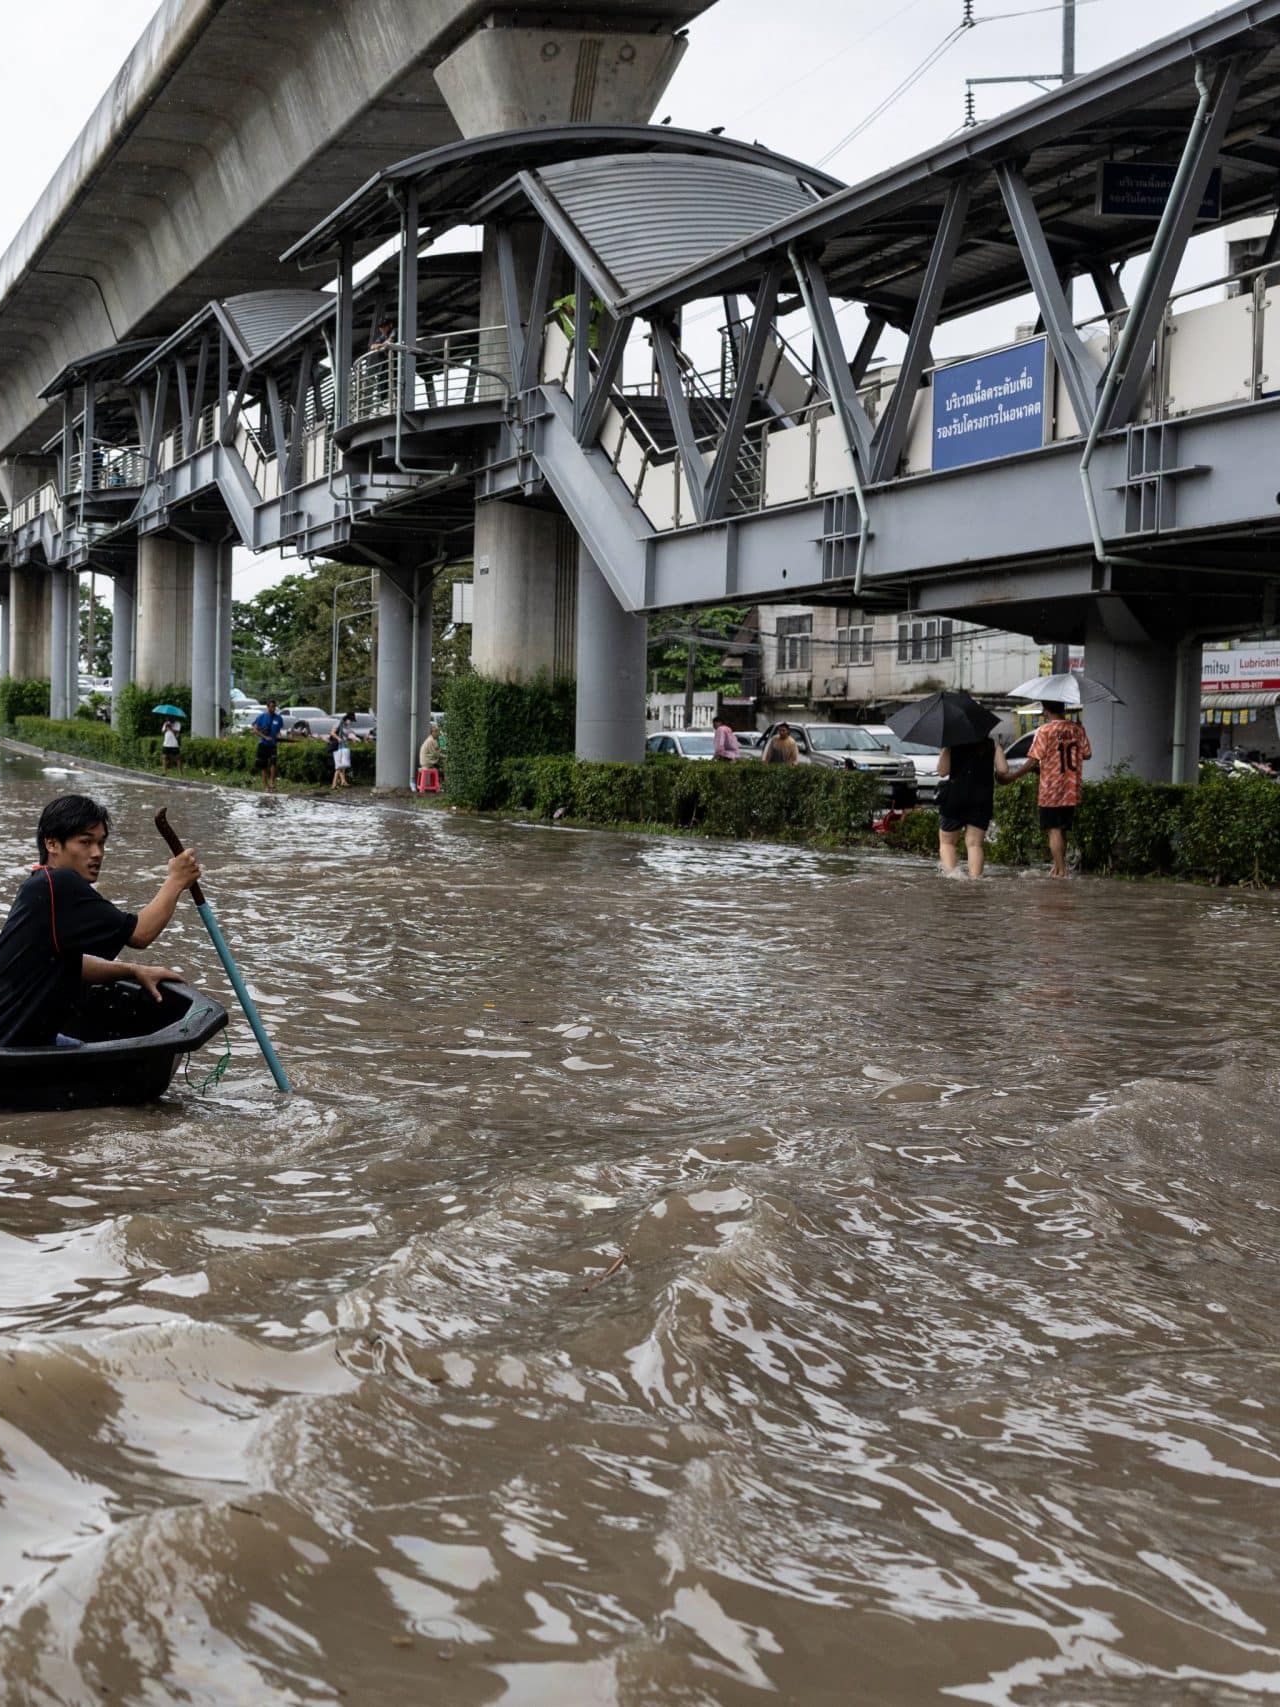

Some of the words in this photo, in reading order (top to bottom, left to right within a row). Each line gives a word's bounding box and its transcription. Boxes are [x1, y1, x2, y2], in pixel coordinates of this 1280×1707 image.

[946, 366, 1033, 411] บริเวณนี้ลดระดับเพื่อ
[936, 401, 1041, 439] รองรับโครงการในอนาคต
[1204, 659, 1230, 674] mitsu
[1240, 657, 1280, 669] Lubricant
[1058, 741, 1080, 773] 10
